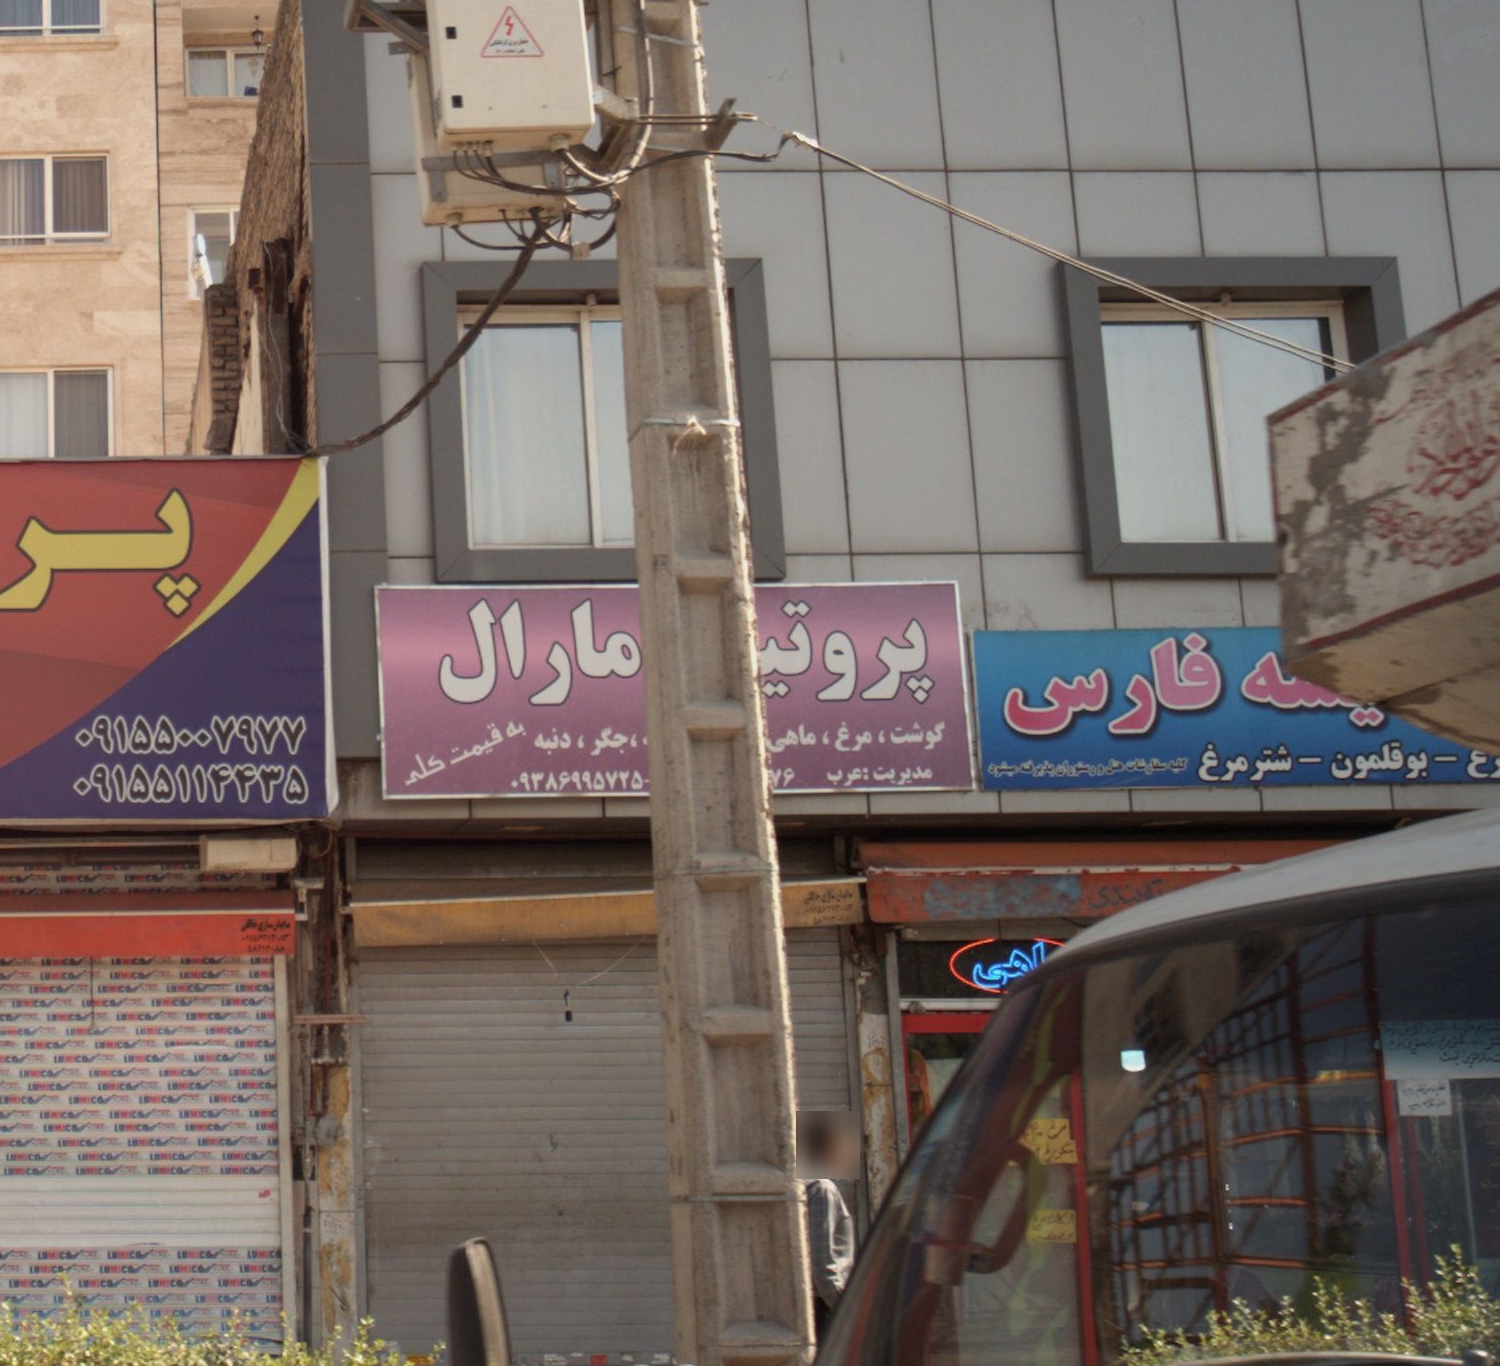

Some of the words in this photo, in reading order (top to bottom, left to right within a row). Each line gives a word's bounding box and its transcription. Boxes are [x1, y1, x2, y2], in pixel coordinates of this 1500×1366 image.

[439, 598, 642, 705] مارال
[762, 601, 936, 704] پروتی
[1004, 632, 1221, 735] فارس
[75, 715, 307, 755] ۰۹۱۵۵۰۰۷۹۷۷
[450, 722, 504, 765] قیمت
[534, 728, 572, 755] دنبه
[766, 725, 817, 753] ماهی
[835, 721, 872, 751] مرغ
[890, 722, 945, 749] گوشت
[873, 766, 933, 785] مدیریت
[1331, 741, 1429, 779] بوقلمون
[73, 764, 309, 804] ۰۹۱۵۵۱۱۴۴۳۵
[972, 941, 1046, 988] اهی
